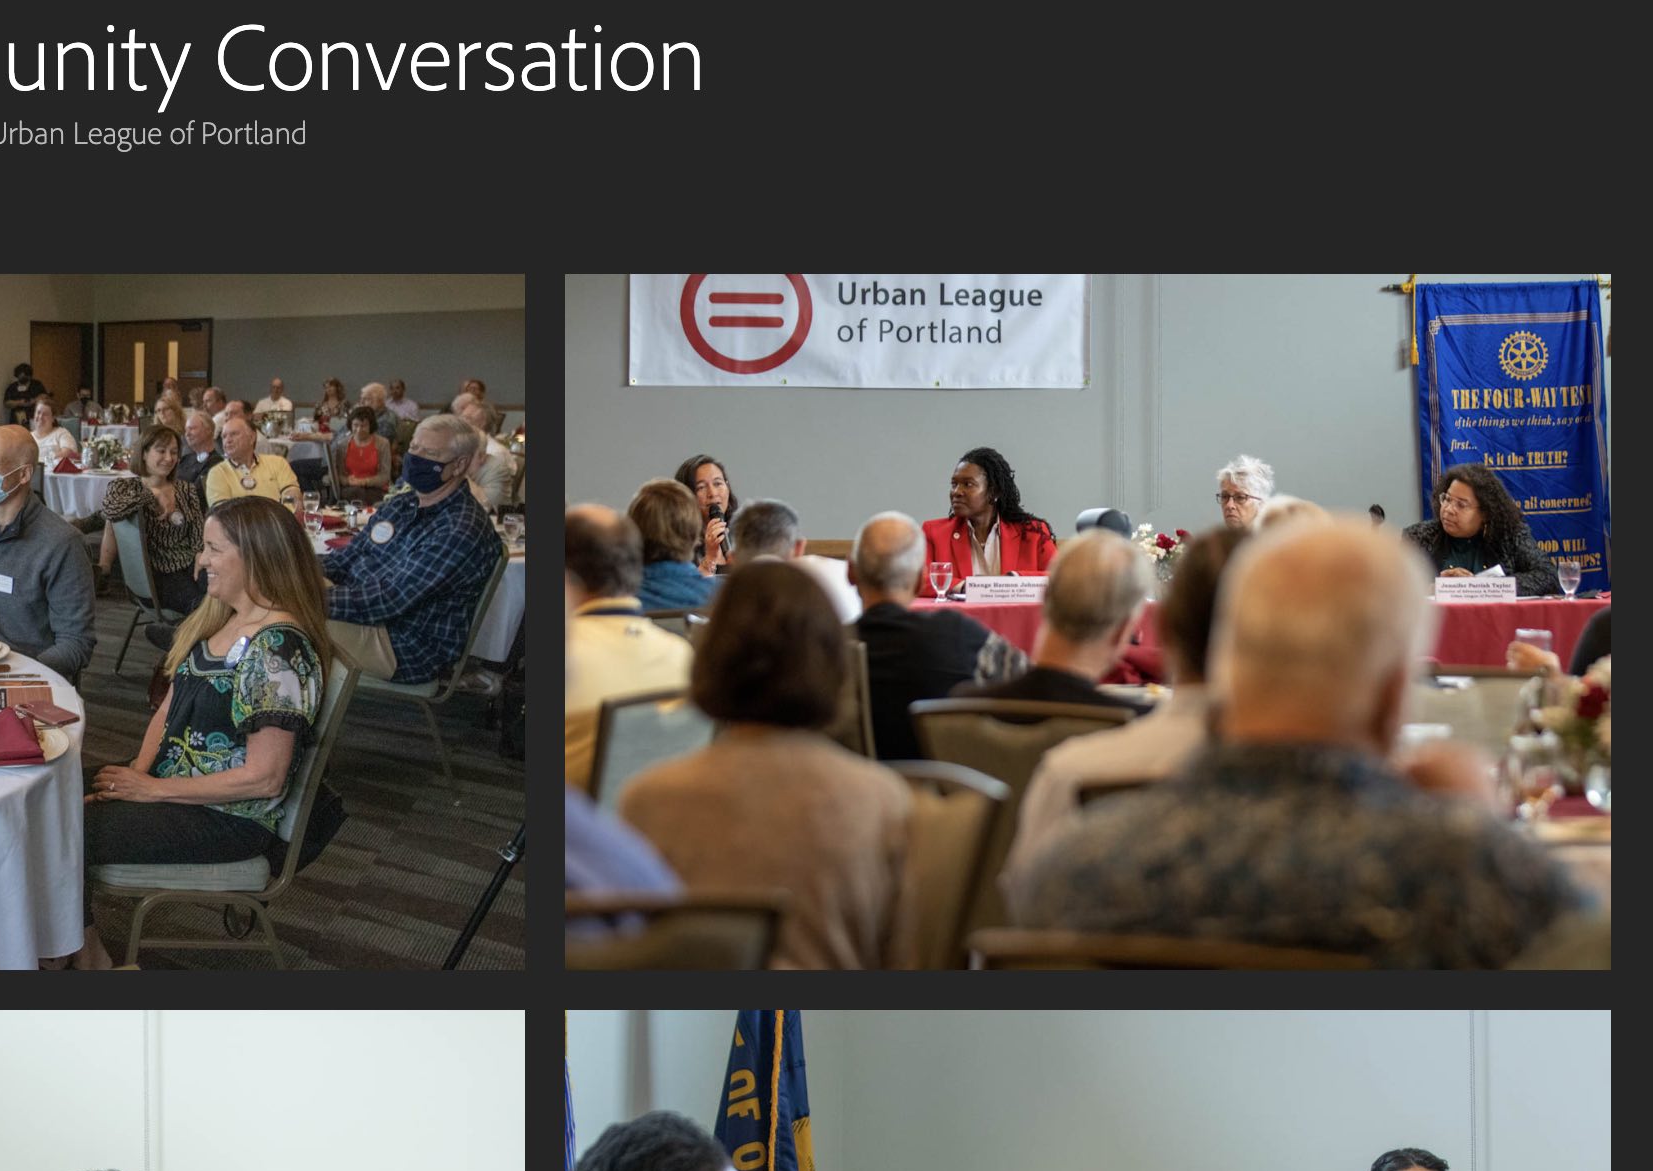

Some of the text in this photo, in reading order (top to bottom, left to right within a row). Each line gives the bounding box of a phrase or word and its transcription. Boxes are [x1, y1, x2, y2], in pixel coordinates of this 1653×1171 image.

[838, 281, 1043, 313] Urban League
[837, 318, 1002, 344] of Portland
[1451, 388, 1480, 410] THE
[1483, 386, 1559, 410] FOUR-WAY
[1478, 415, 1510, 429] things
[1511, 418, 1525, 427] we
[1483, 450, 1568, 466] Is it the TRUTH?
[1537, 540, 1559, 553] OOD
[727, 1068, 761, 1121] OF
